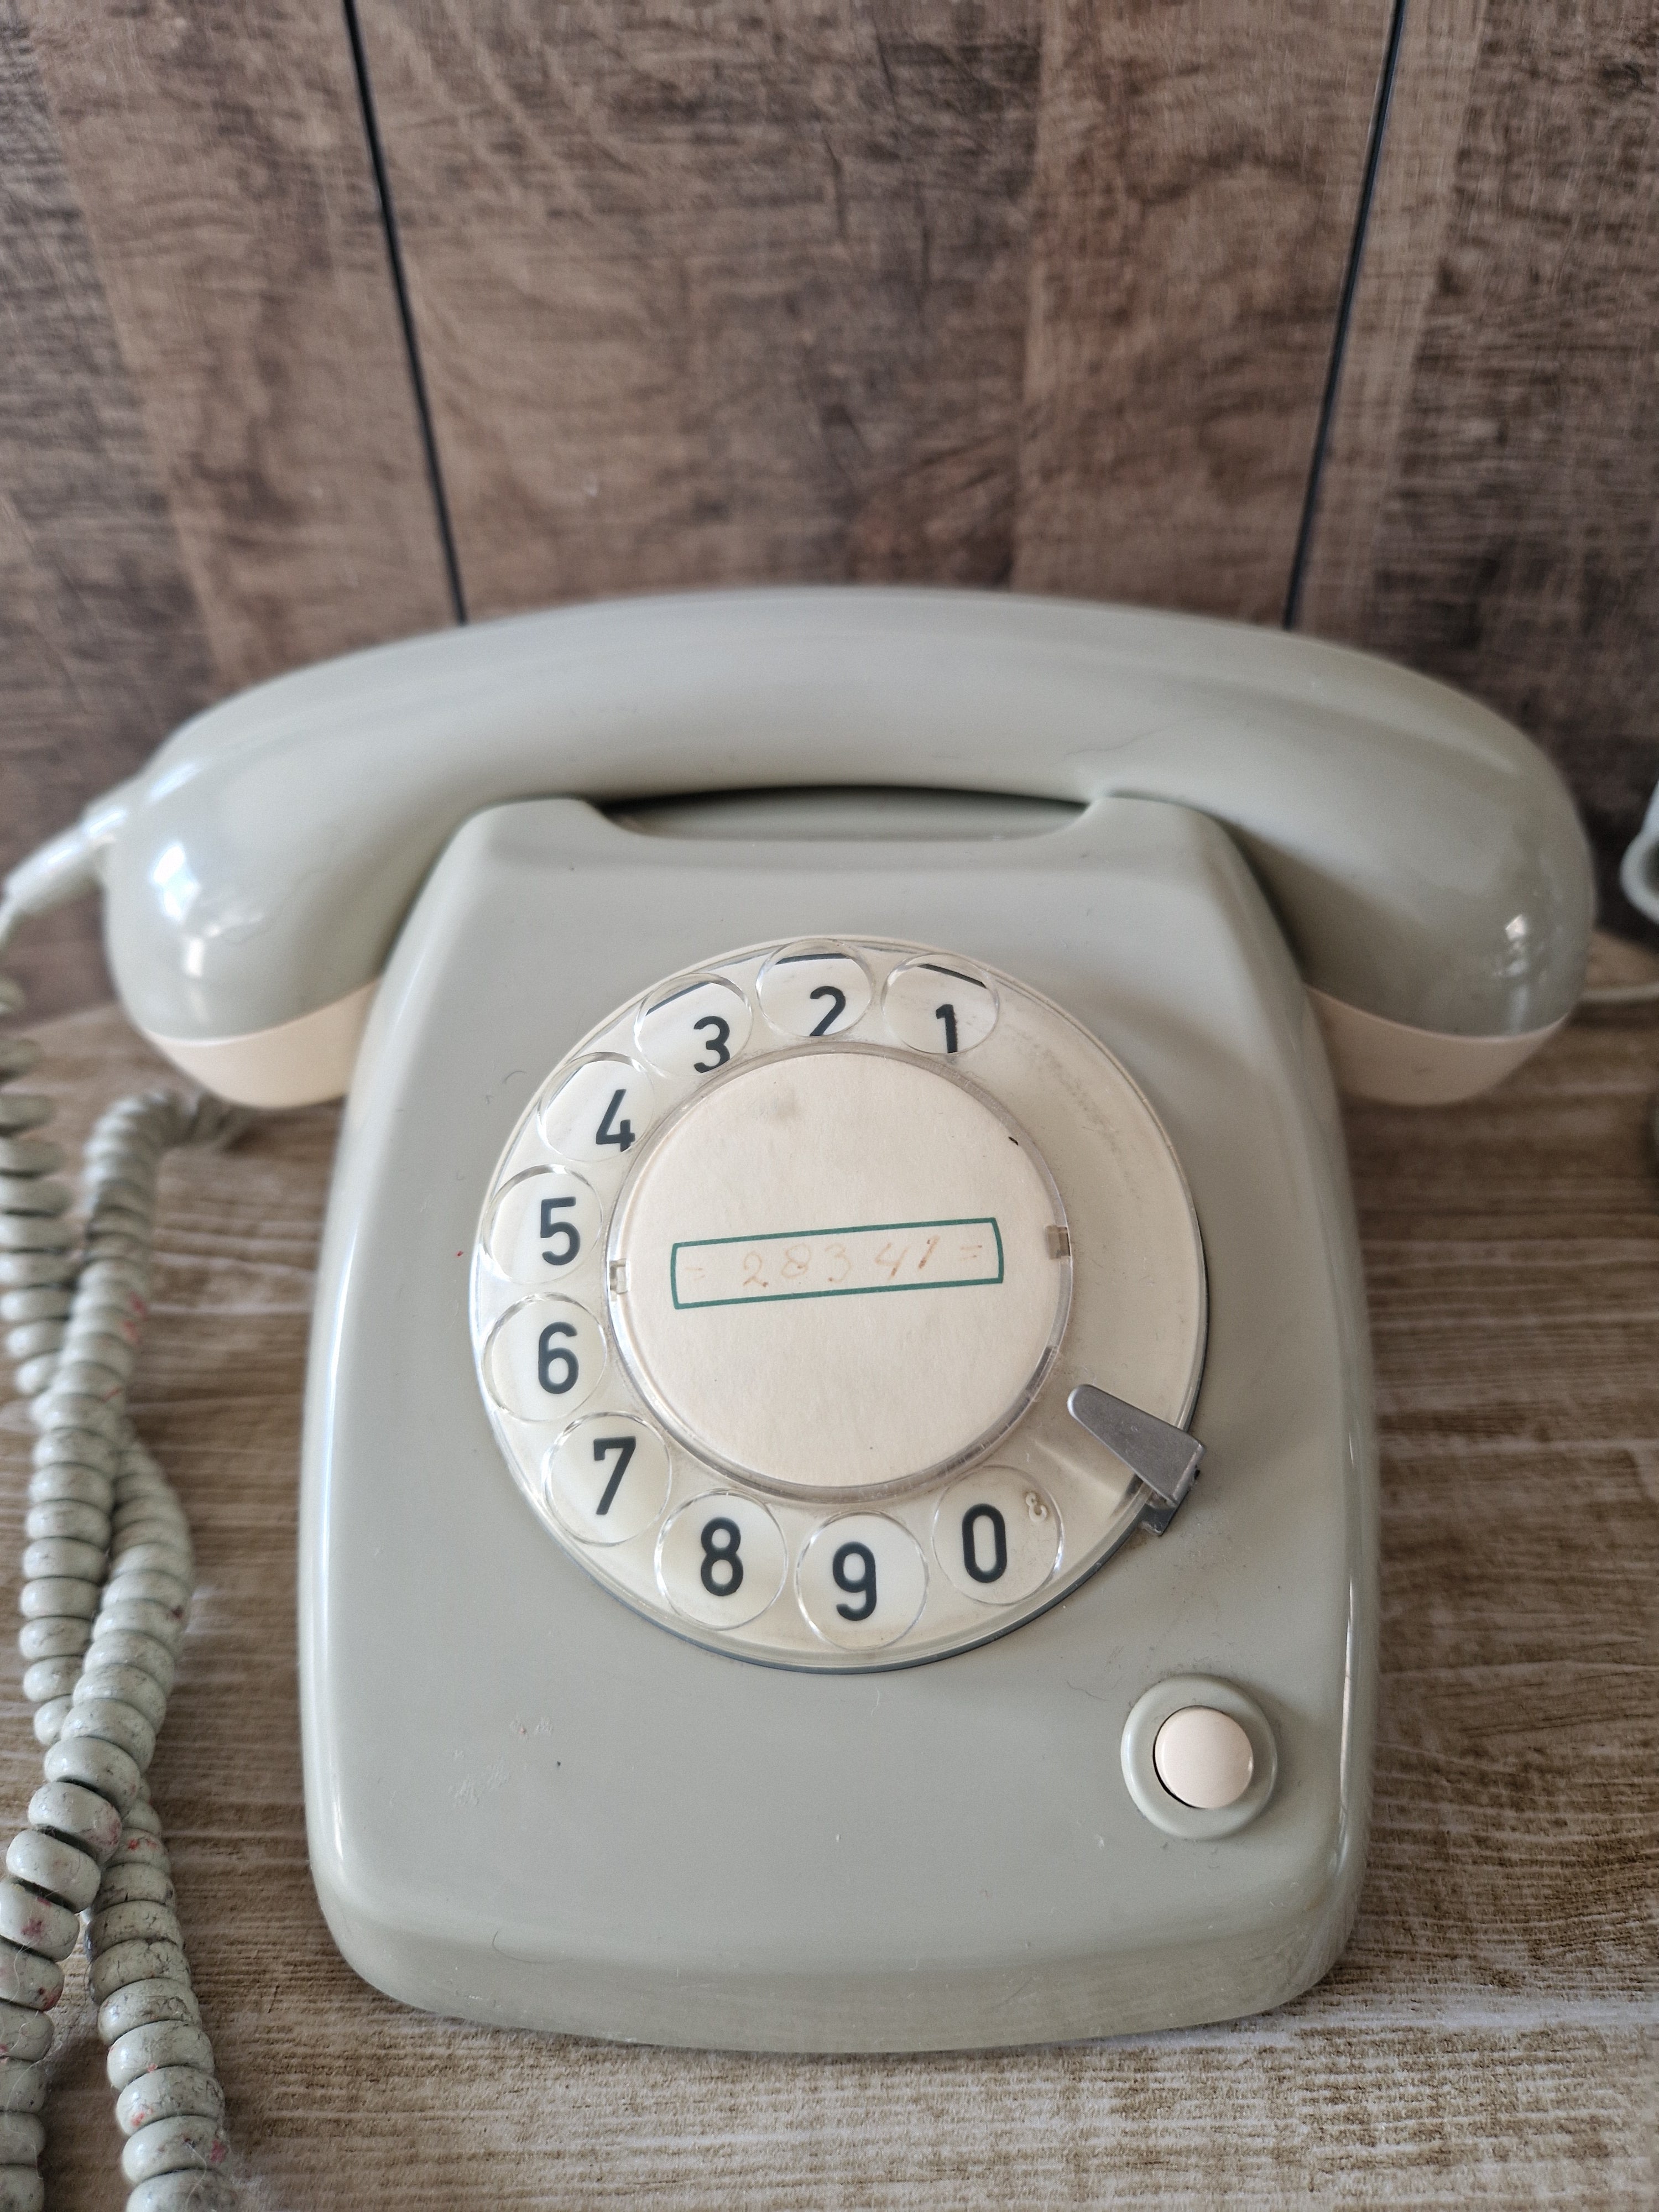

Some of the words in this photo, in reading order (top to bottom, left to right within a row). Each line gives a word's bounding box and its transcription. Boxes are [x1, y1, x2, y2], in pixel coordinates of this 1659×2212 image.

[693, 1015, 731, 1074] 3
[808, 985, 847, 1037] 2
[935, 1003, 958, 1055] 1
[595, 1088, 636, 1152] 4
[540, 1196, 580, 1266] 5
[538, 1322, 578, 1395] 6
[593, 1436, 637, 1515] 7
[700, 1517, 745, 1598] 8
[961, 1503, 1008, 1584] 0
[832, 1541, 878, 1622] 9
